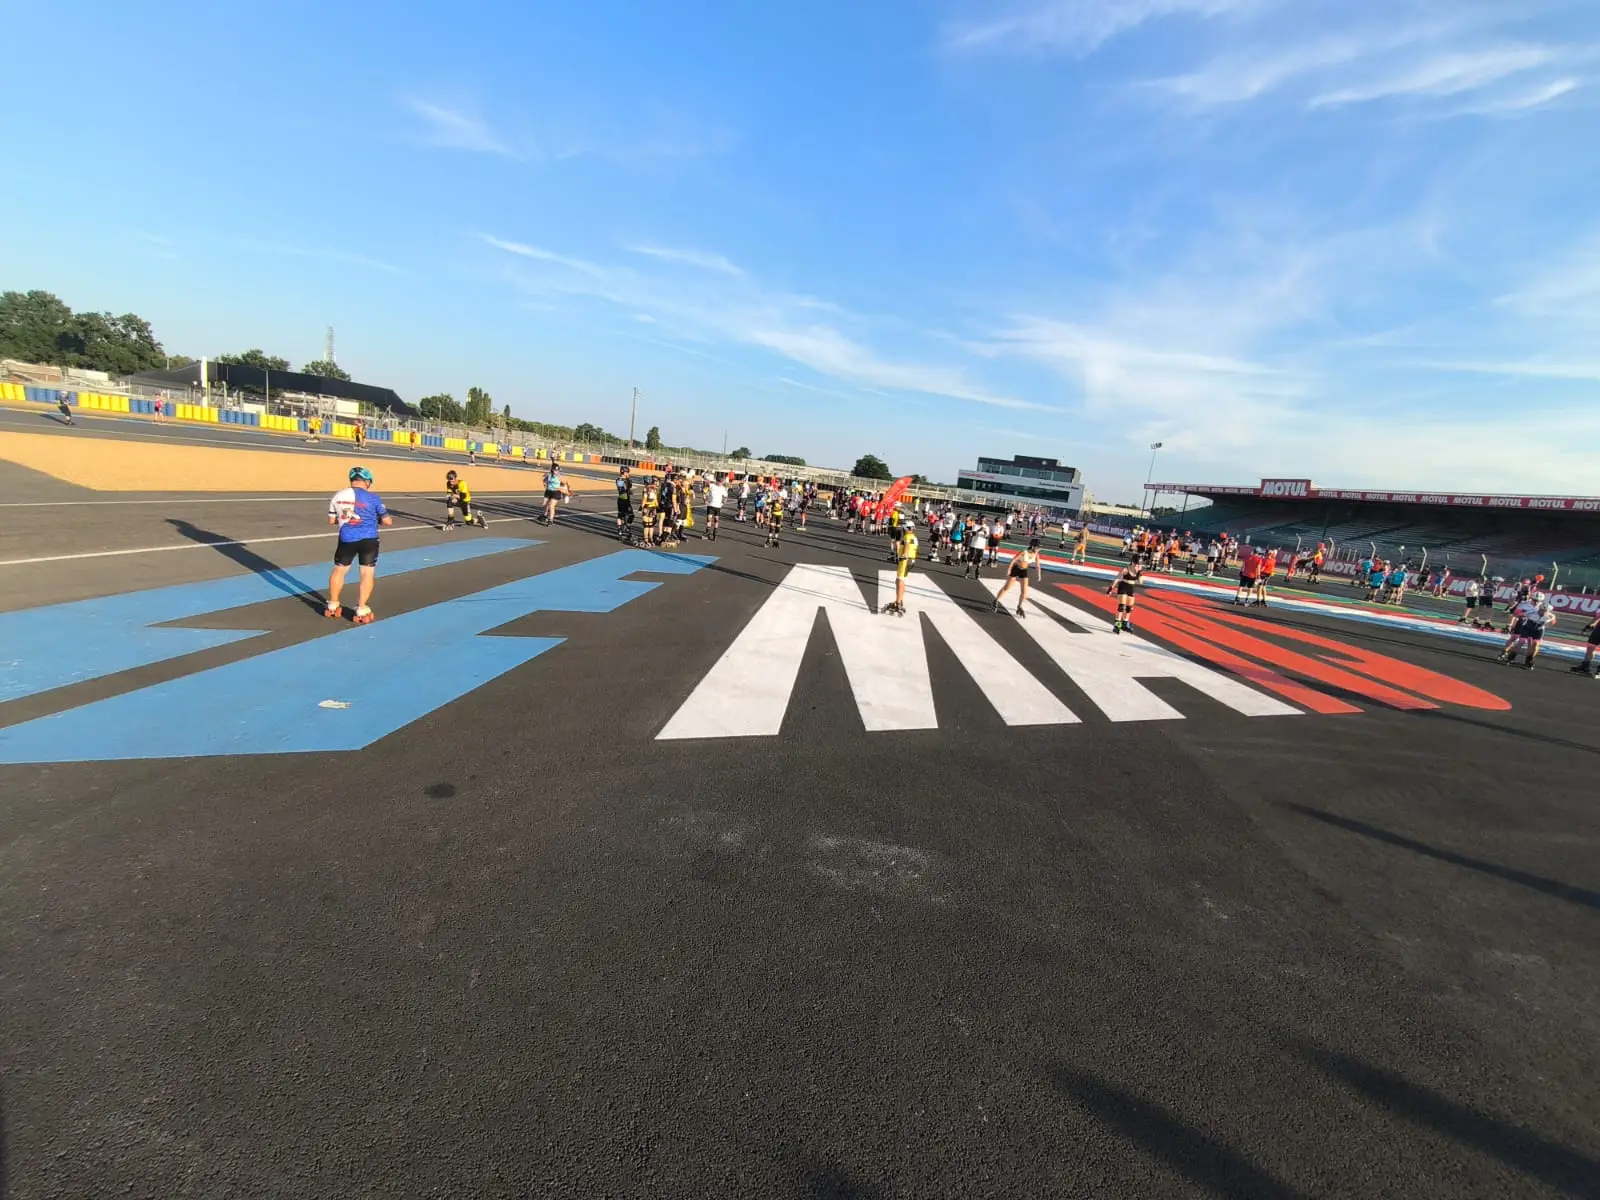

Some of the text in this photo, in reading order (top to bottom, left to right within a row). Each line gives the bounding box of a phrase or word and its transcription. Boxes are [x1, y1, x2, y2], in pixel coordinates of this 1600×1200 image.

[1262, 481, 1308, 497] MOTUL
[1366, 492, 1388, 501] MOTUL
[1392, 493, 1417, 502] MOTUL
[1421, 495, 1448, 504] MOTUL
[1452, 496, 1483, 505] MOTUL
[1488, 497, 1522, 507] MOTUL
[1528, 498, 1567, 508] MOTUL
[1572, 500, 1600, 510] MOT
[1545, 592, 1599, 613] OTU
[0, 538, 1511, 764] LE MANS
